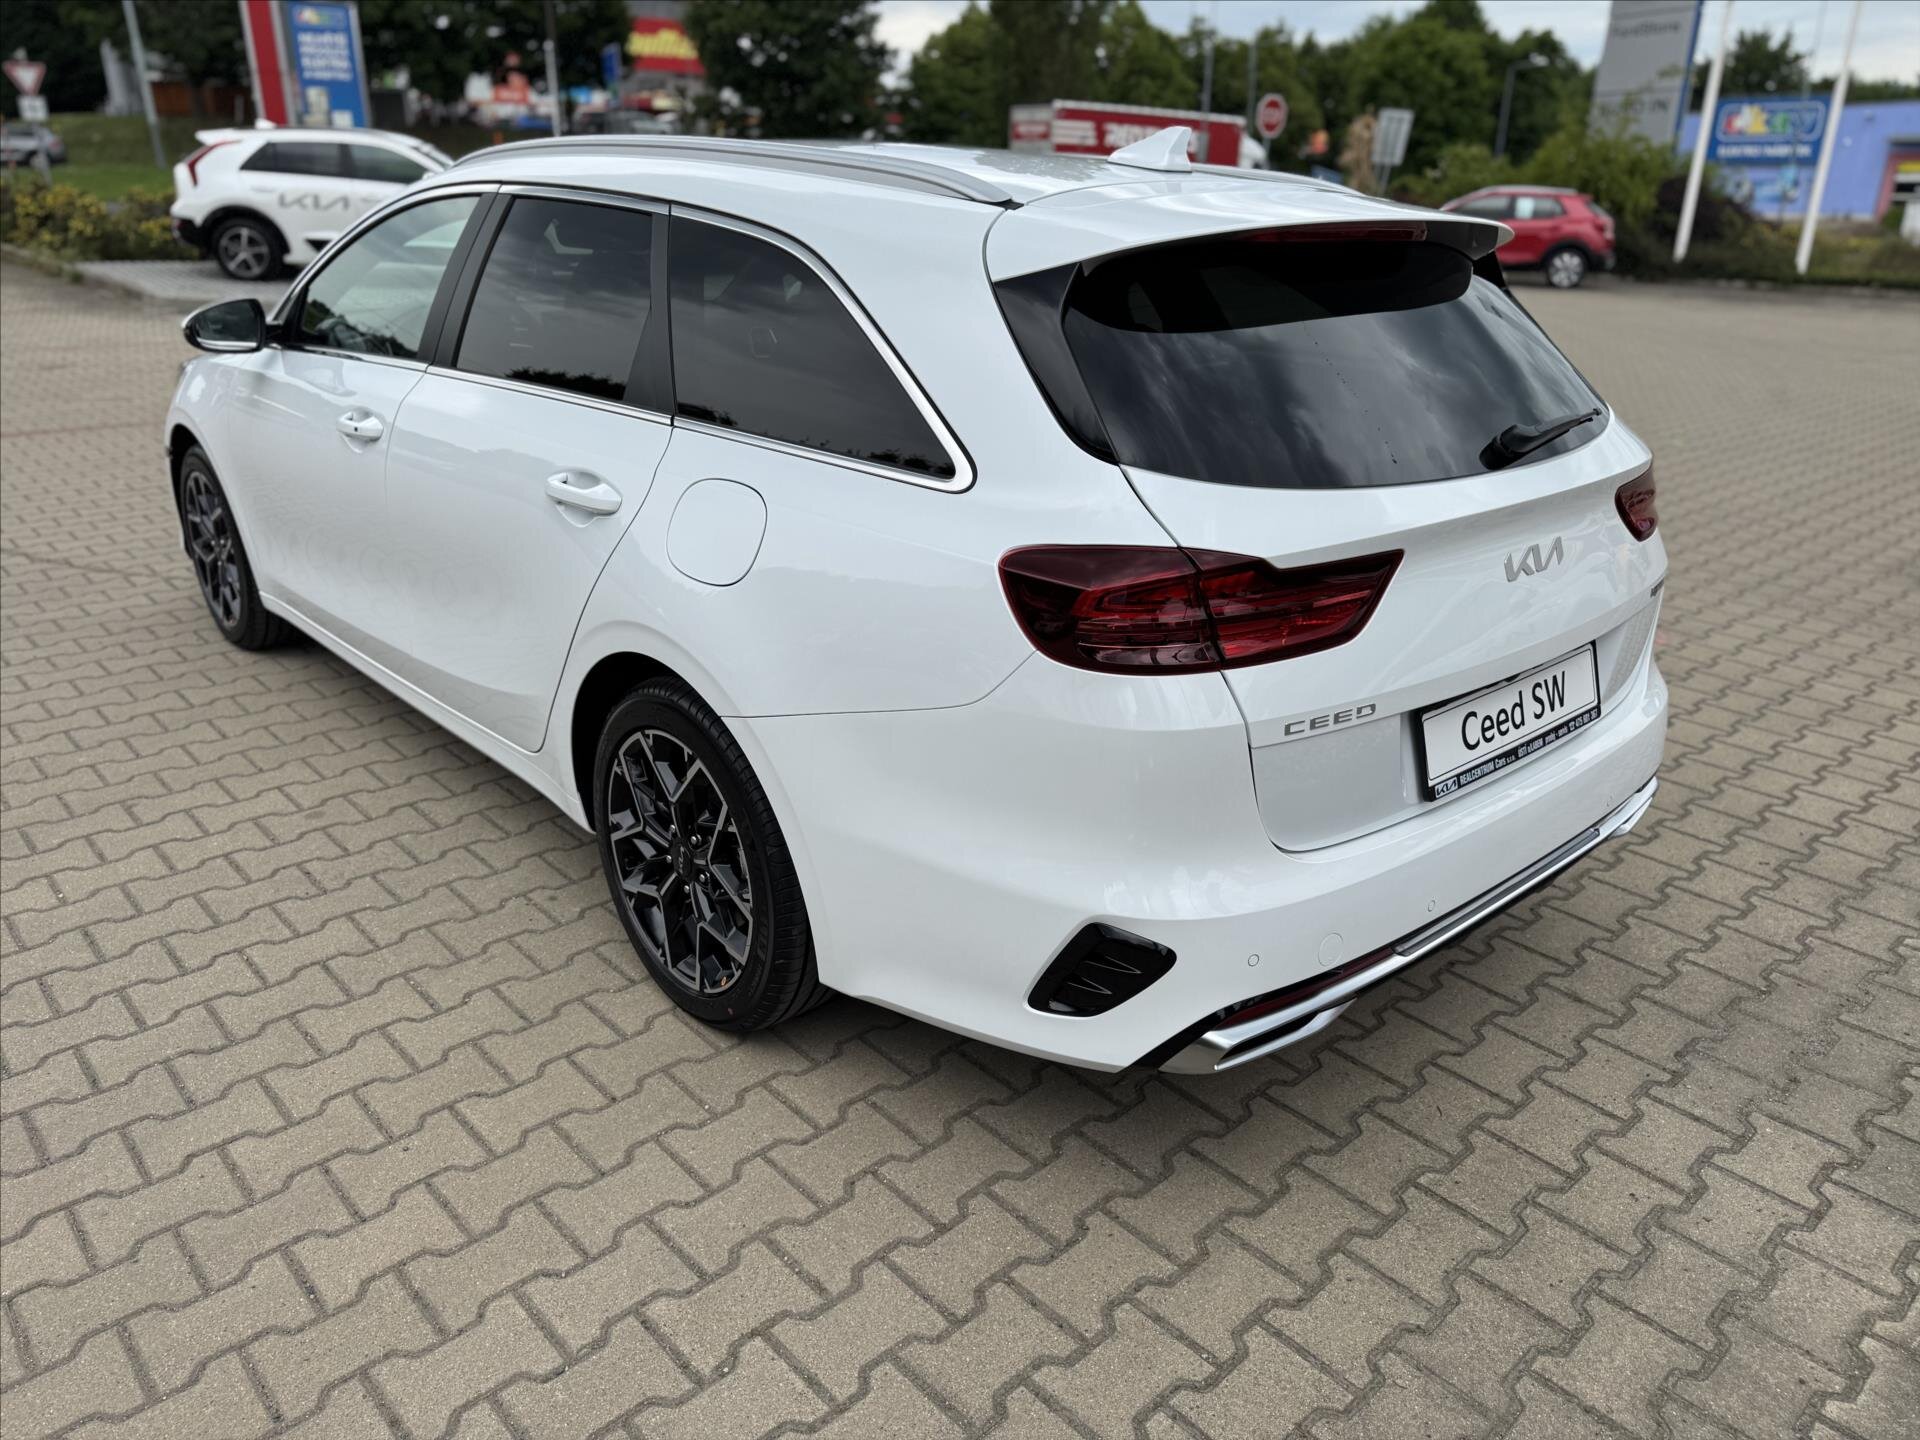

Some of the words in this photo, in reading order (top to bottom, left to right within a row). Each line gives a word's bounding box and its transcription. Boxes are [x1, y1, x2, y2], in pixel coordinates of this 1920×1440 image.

[1504, 536, 1564, 582] KIA
[1284, 703, 1376, 736] CEED
[1461, 690, 1525, 750] Ceed
[1532, 671, 1566, 719] SW
[1436, 780, 1457, 796] KIA
